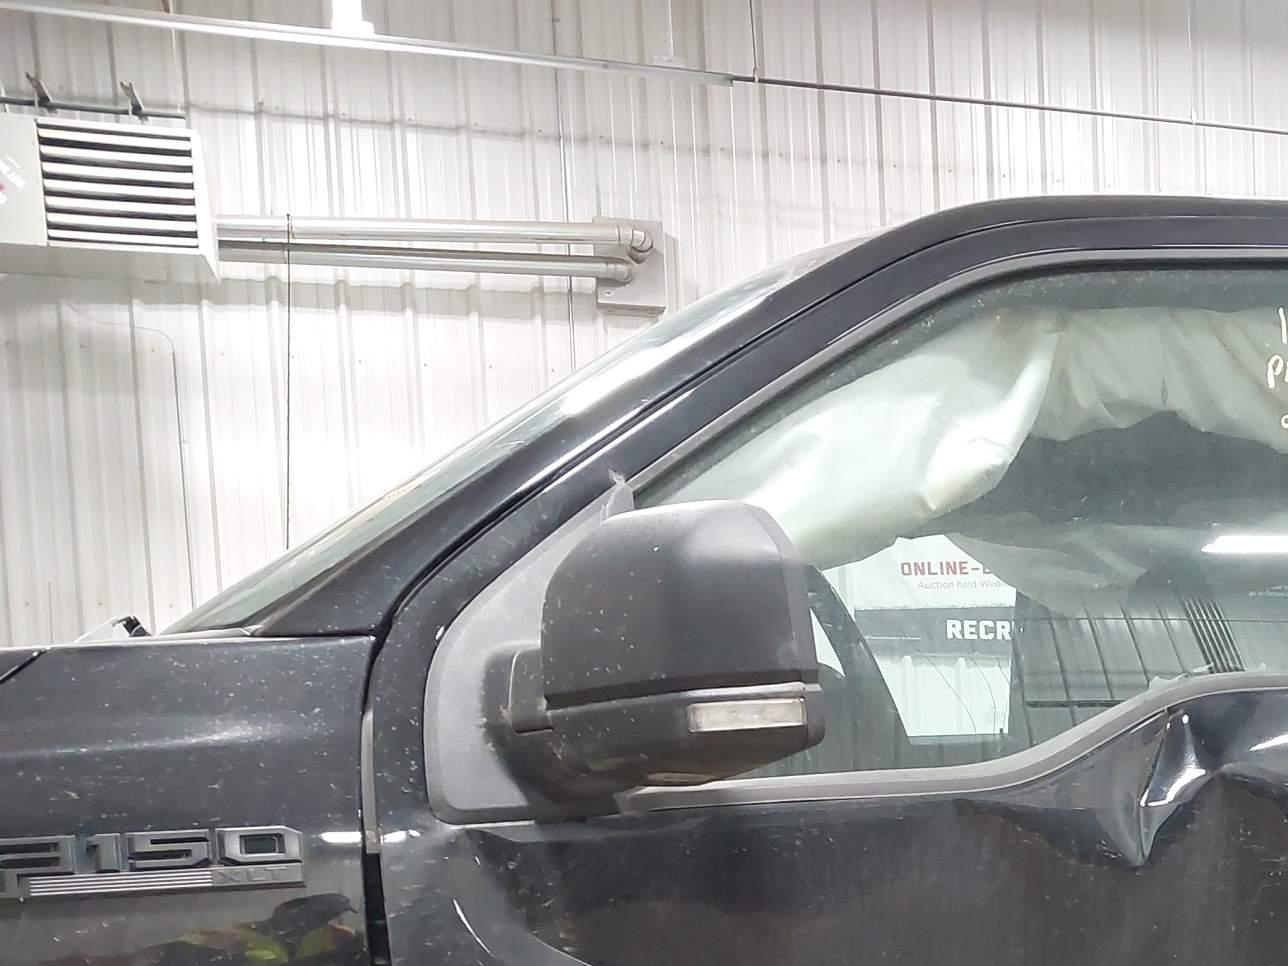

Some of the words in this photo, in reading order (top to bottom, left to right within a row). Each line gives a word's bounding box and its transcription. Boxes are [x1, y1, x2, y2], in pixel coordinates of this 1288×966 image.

[918, 580, 954, 590] Auction
[957, 579, 977, 589] held
[945, 619, 1015, 641] RECR
[216, 866, 289, 883] XLT
